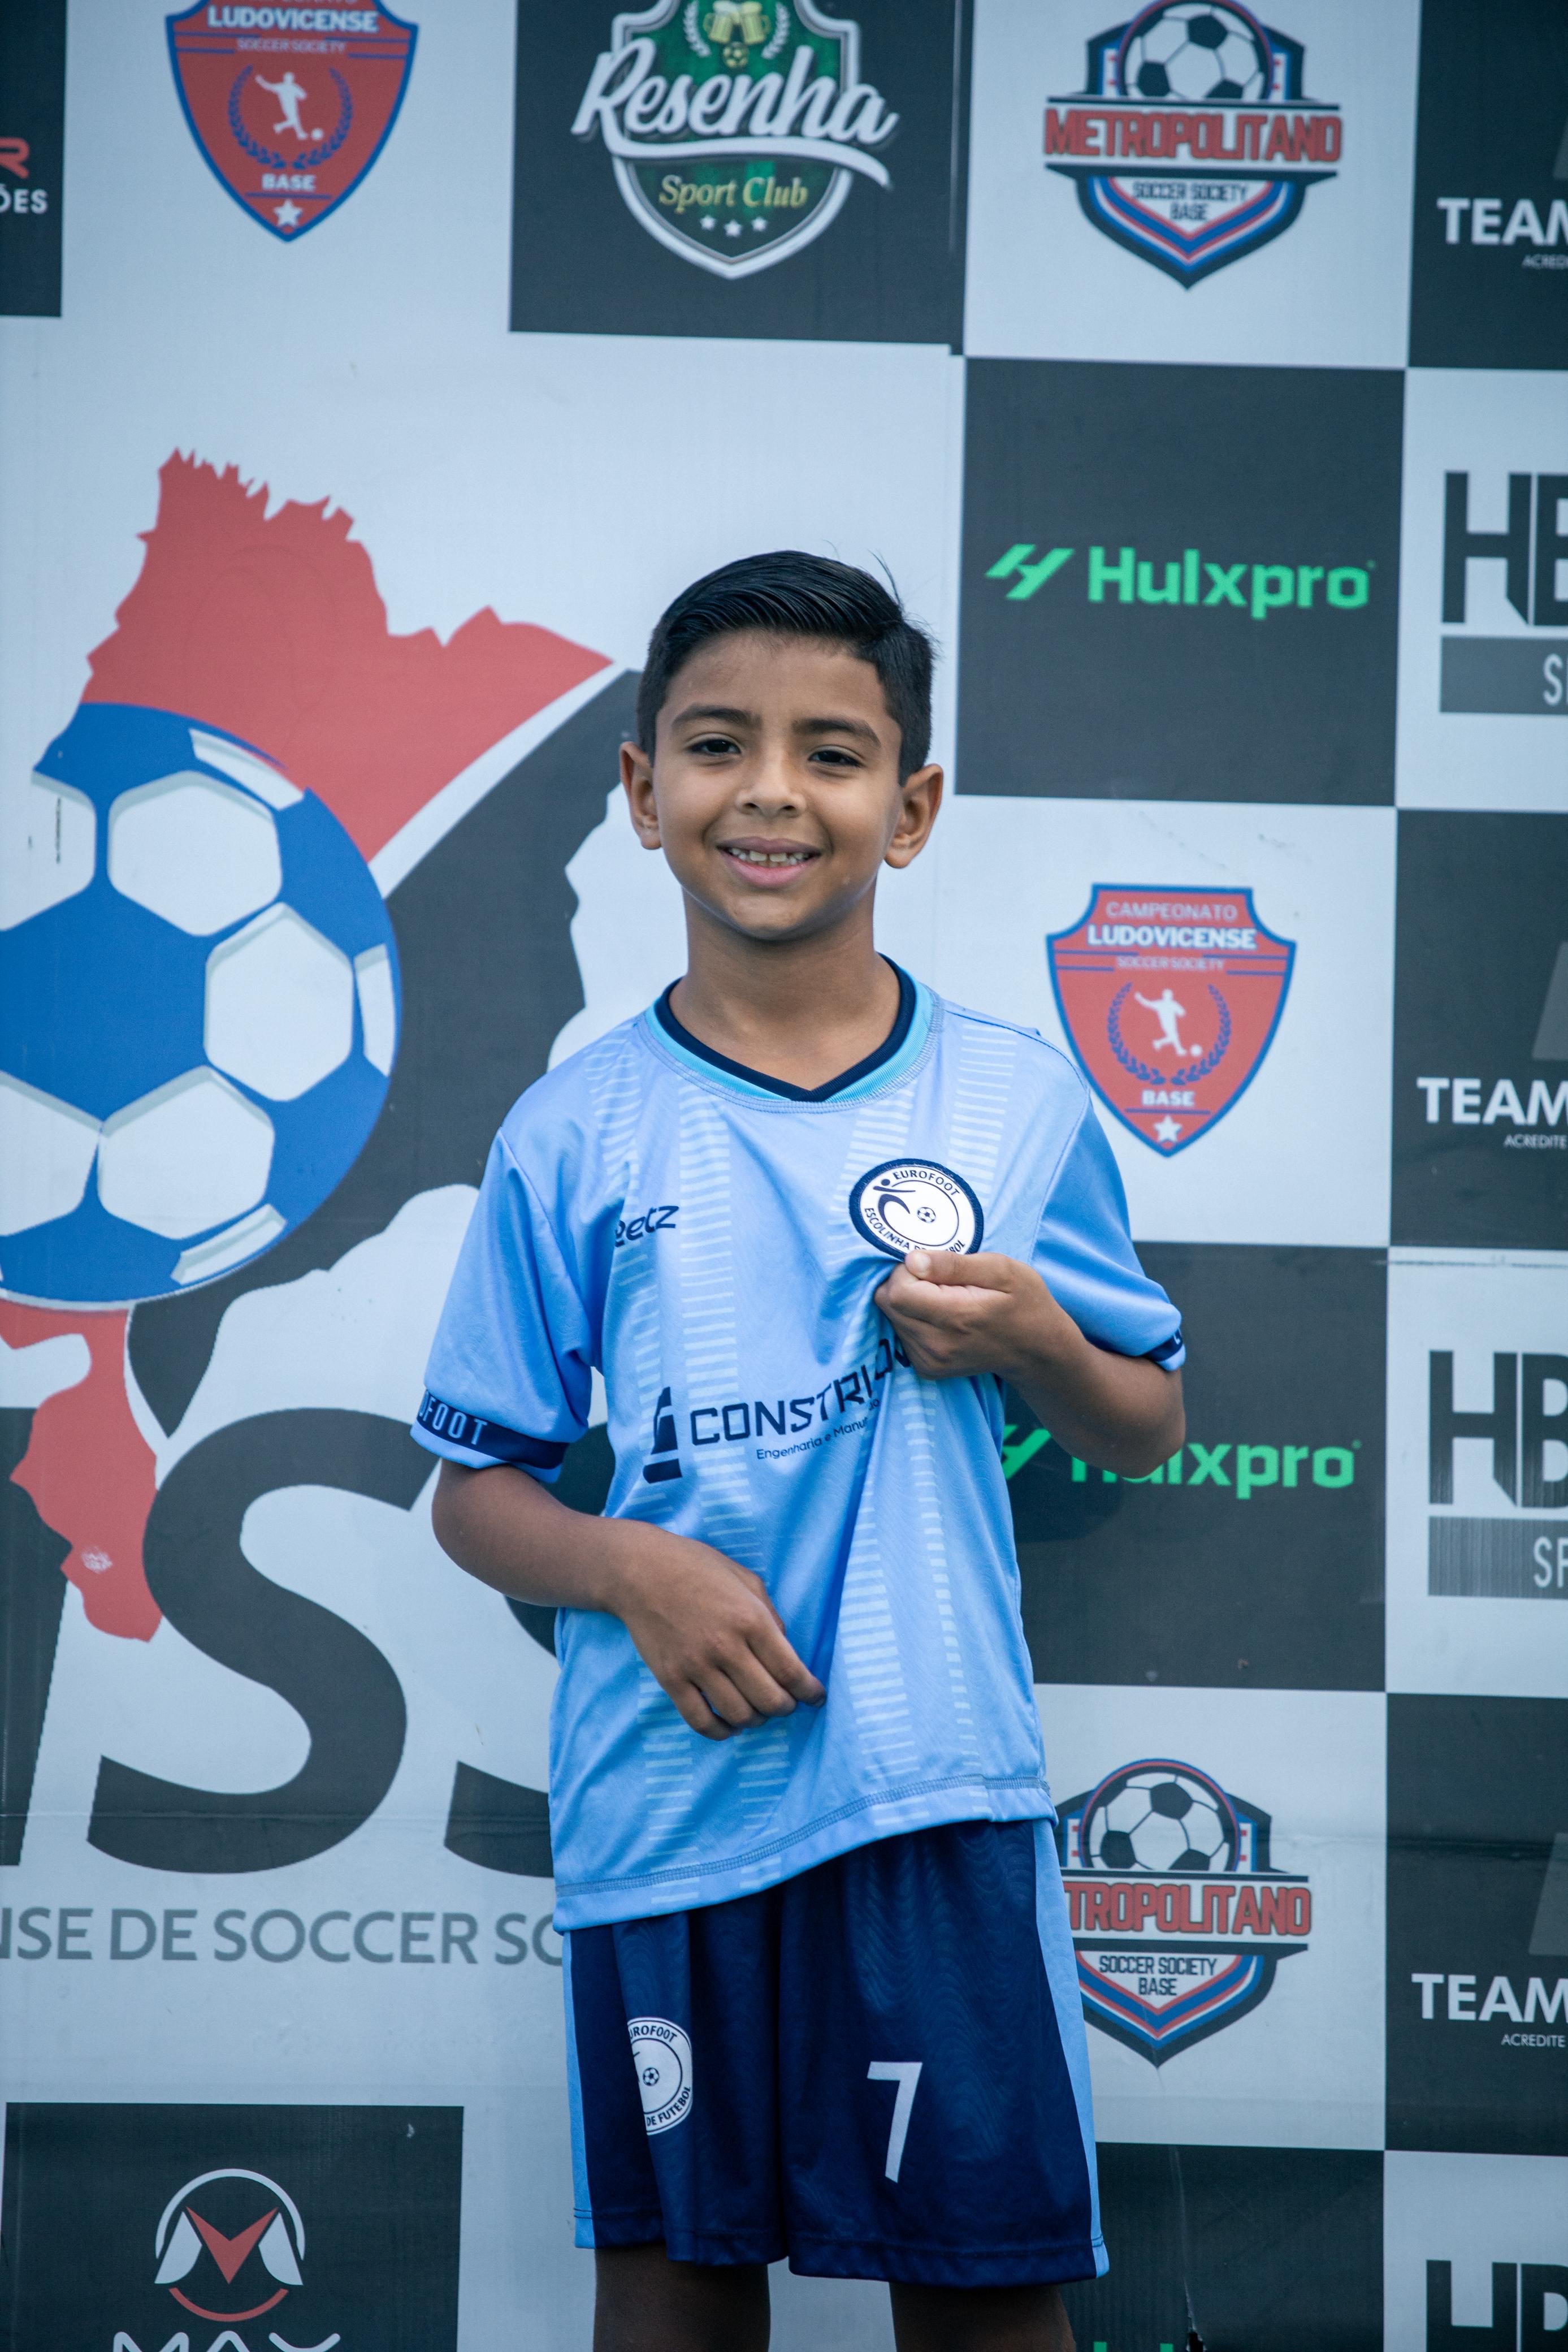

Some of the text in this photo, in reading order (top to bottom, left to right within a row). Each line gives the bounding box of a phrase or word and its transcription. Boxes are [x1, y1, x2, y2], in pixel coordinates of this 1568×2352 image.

[207, 5, 379, 33] LUDOVICENSE
[571, 37, 900, 188] Resenha
[1044, 109, 1342, 162] METROPOLITANO
[262, 172, 317, 191] BASE
[659, 175, 808, 214] Sport Club
[1133, 181, 1248, 202] SOCCER SOCIETY
[1170, 204, 1209, 220] BASE
[1089, 546, 1370, 621] Hulxpro
[1106, 901, 1238, 922] CAMPEONATO
[1088, 923, 1258, 950] LUDOVICENSE
[1142, 1089, 1195, 1106] BASE
[1502, 1134, 1567, 1150] ACREDITE
[893, 1170, 960, 1196] EUROFOOT
[864, 1207, 909, 1251] ESCOLINHA
[756, 1438, 822, 1460] Engenharia
[824, 1433, 833, 1442] e
[0, 1907, 93, 1960] SE
[110, 1909, 198, 1961] DE
[213, 1909, 478, 1964] SOCCER
[1099, 1955, 1217, 1975] SOCCER SOCIETY
[1138, 1977, 1177, 1996] BASE
[1501, 2033, 1566, 2048] ACREDITE
[657, 2086, 691, 2125] FUTEBOL
[867, 2061, 923, 2184] 7
